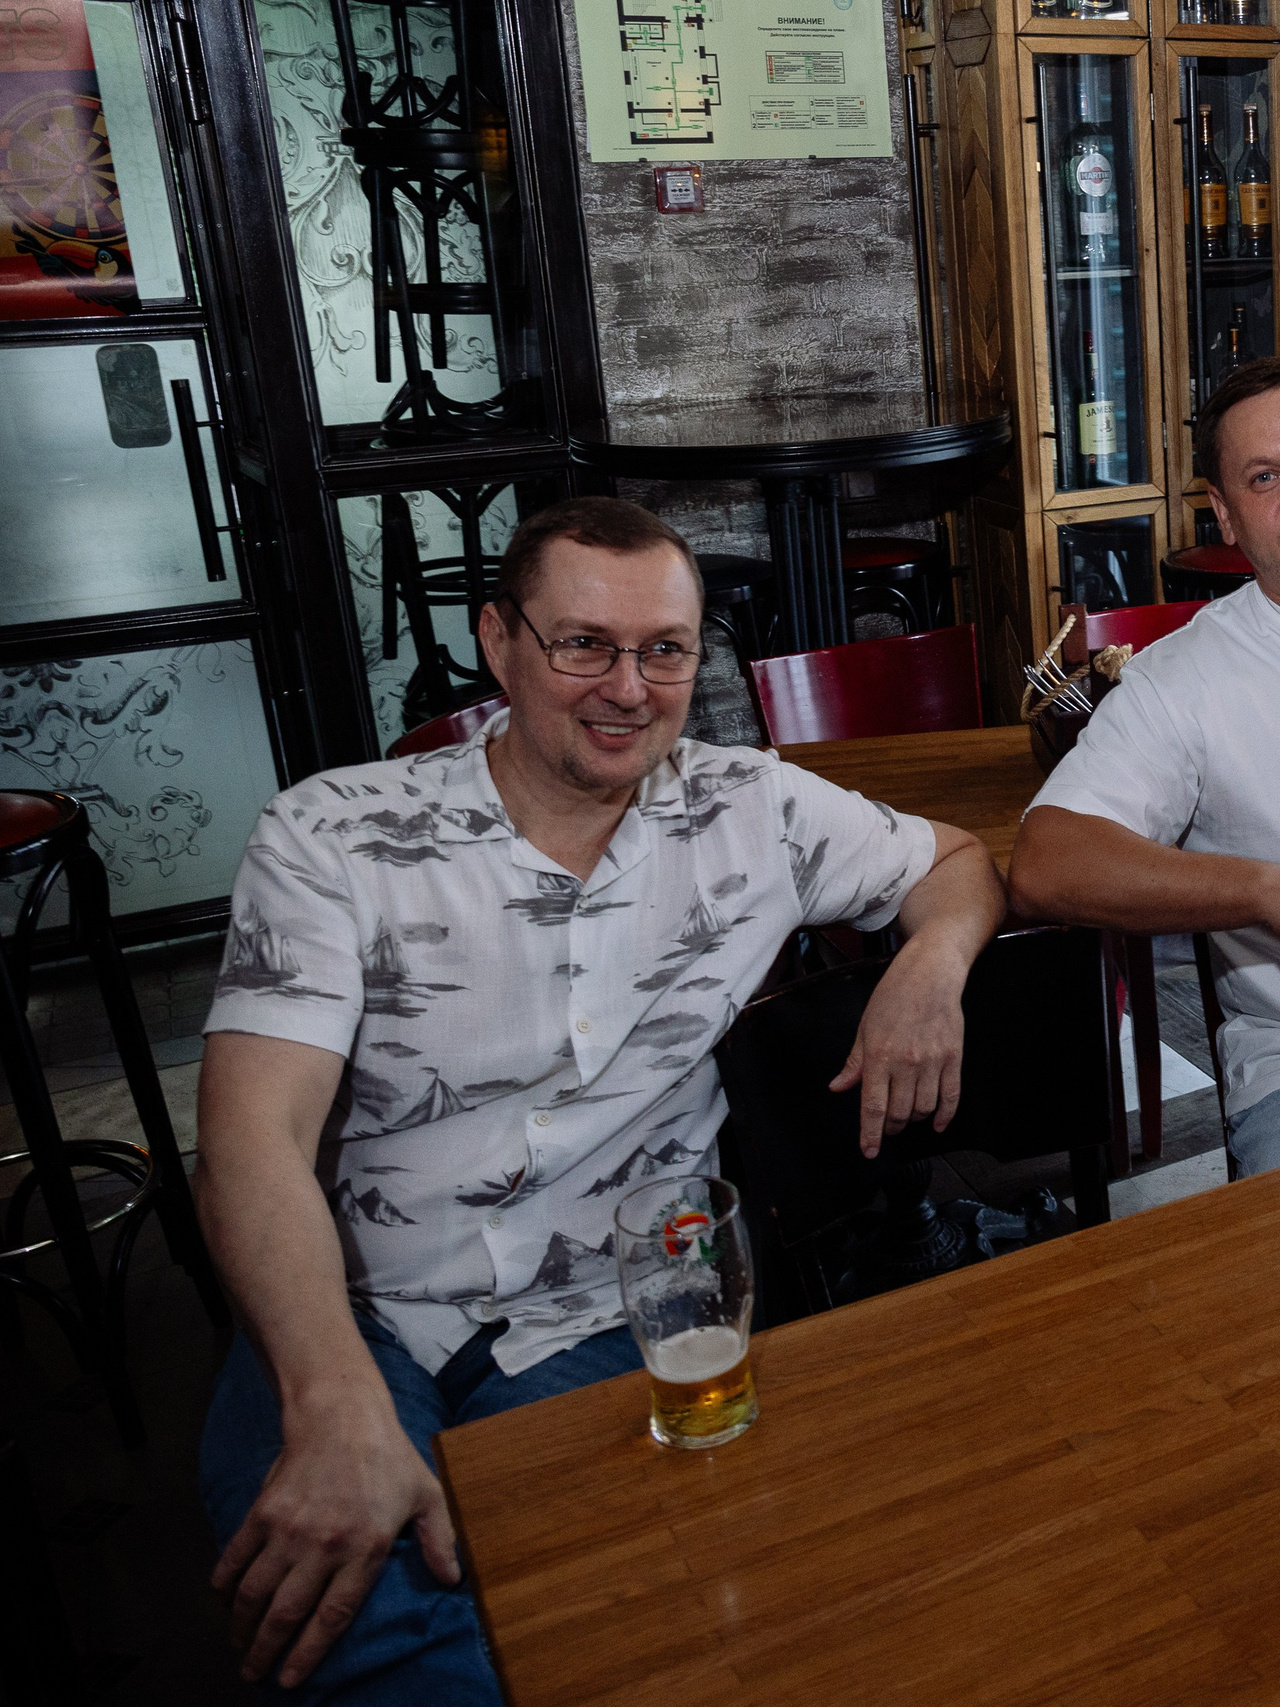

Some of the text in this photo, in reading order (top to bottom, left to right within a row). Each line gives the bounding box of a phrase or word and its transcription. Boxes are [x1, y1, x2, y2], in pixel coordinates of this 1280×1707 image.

[777, 17, 825, 25] ВНИМАНИЕ!
[1081, 171, 1110, 180] MARTIN
[1086, 405, 1114, 418] JAMES
